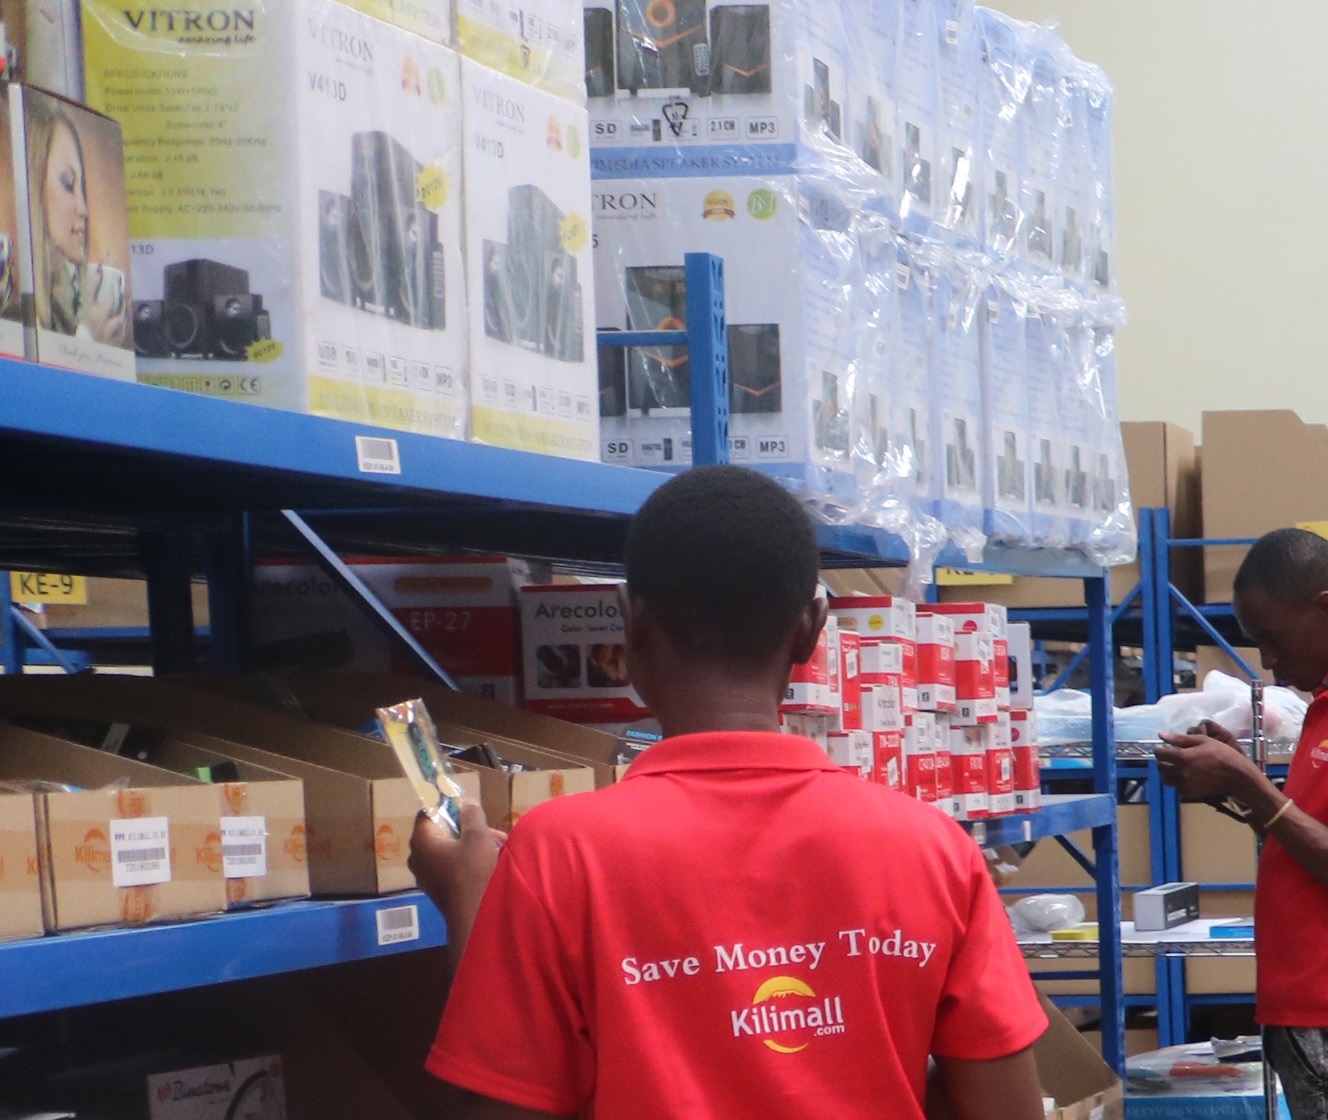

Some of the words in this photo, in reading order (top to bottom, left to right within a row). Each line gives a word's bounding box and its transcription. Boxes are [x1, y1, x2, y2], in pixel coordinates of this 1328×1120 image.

[124, 10, 255, 32] VITRON
[306, 17, 375, 62] VITRON
[471, 85, 526, 123] VITRON
[595, 123, 617, 135] SD
[710, 120, 735, 132] 2.1CH
[748, 122, 776, 134] MP3
[607, 442, 629, 454] SD
[759, 441, 786, 452] MP3
[20, 574, 74, 596] KE-9
[620, 954, 700, 985] Save
[714, 941, 826, 973] Money
[838, 928, 936, 968] Today
[730, 996, 844, 1037] Kilimall
[813, 1022, 845, 1036] .com
